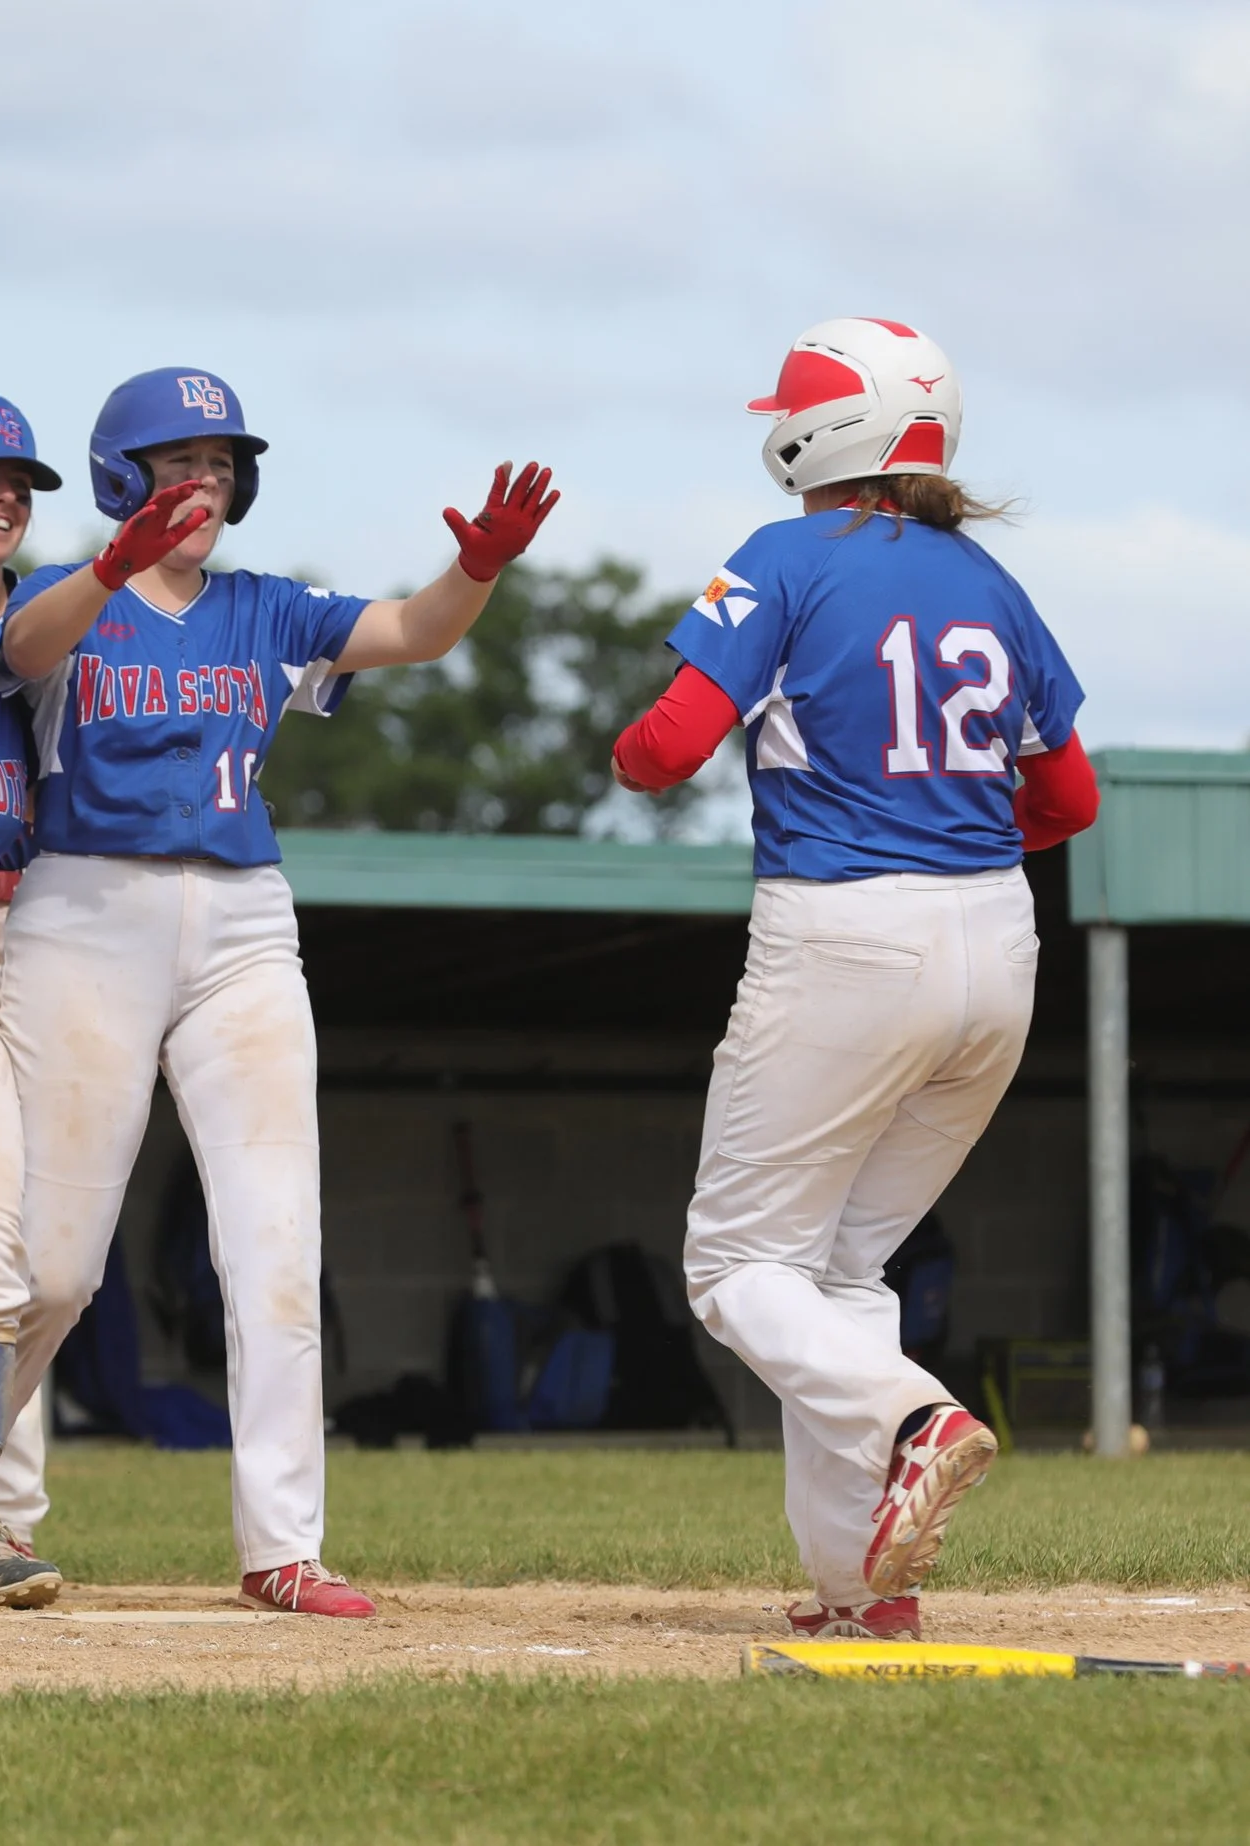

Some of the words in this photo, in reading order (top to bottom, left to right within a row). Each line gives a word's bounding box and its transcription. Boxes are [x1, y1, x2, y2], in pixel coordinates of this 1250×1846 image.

[177, 376, 227, 420] NS
[77, 653, 168, 727] NOVA
[177, 659, 268, 732] SCOTIA
[877, 615, 1013, 778] 12
[862, 1662, 980, 1678] EASTON
